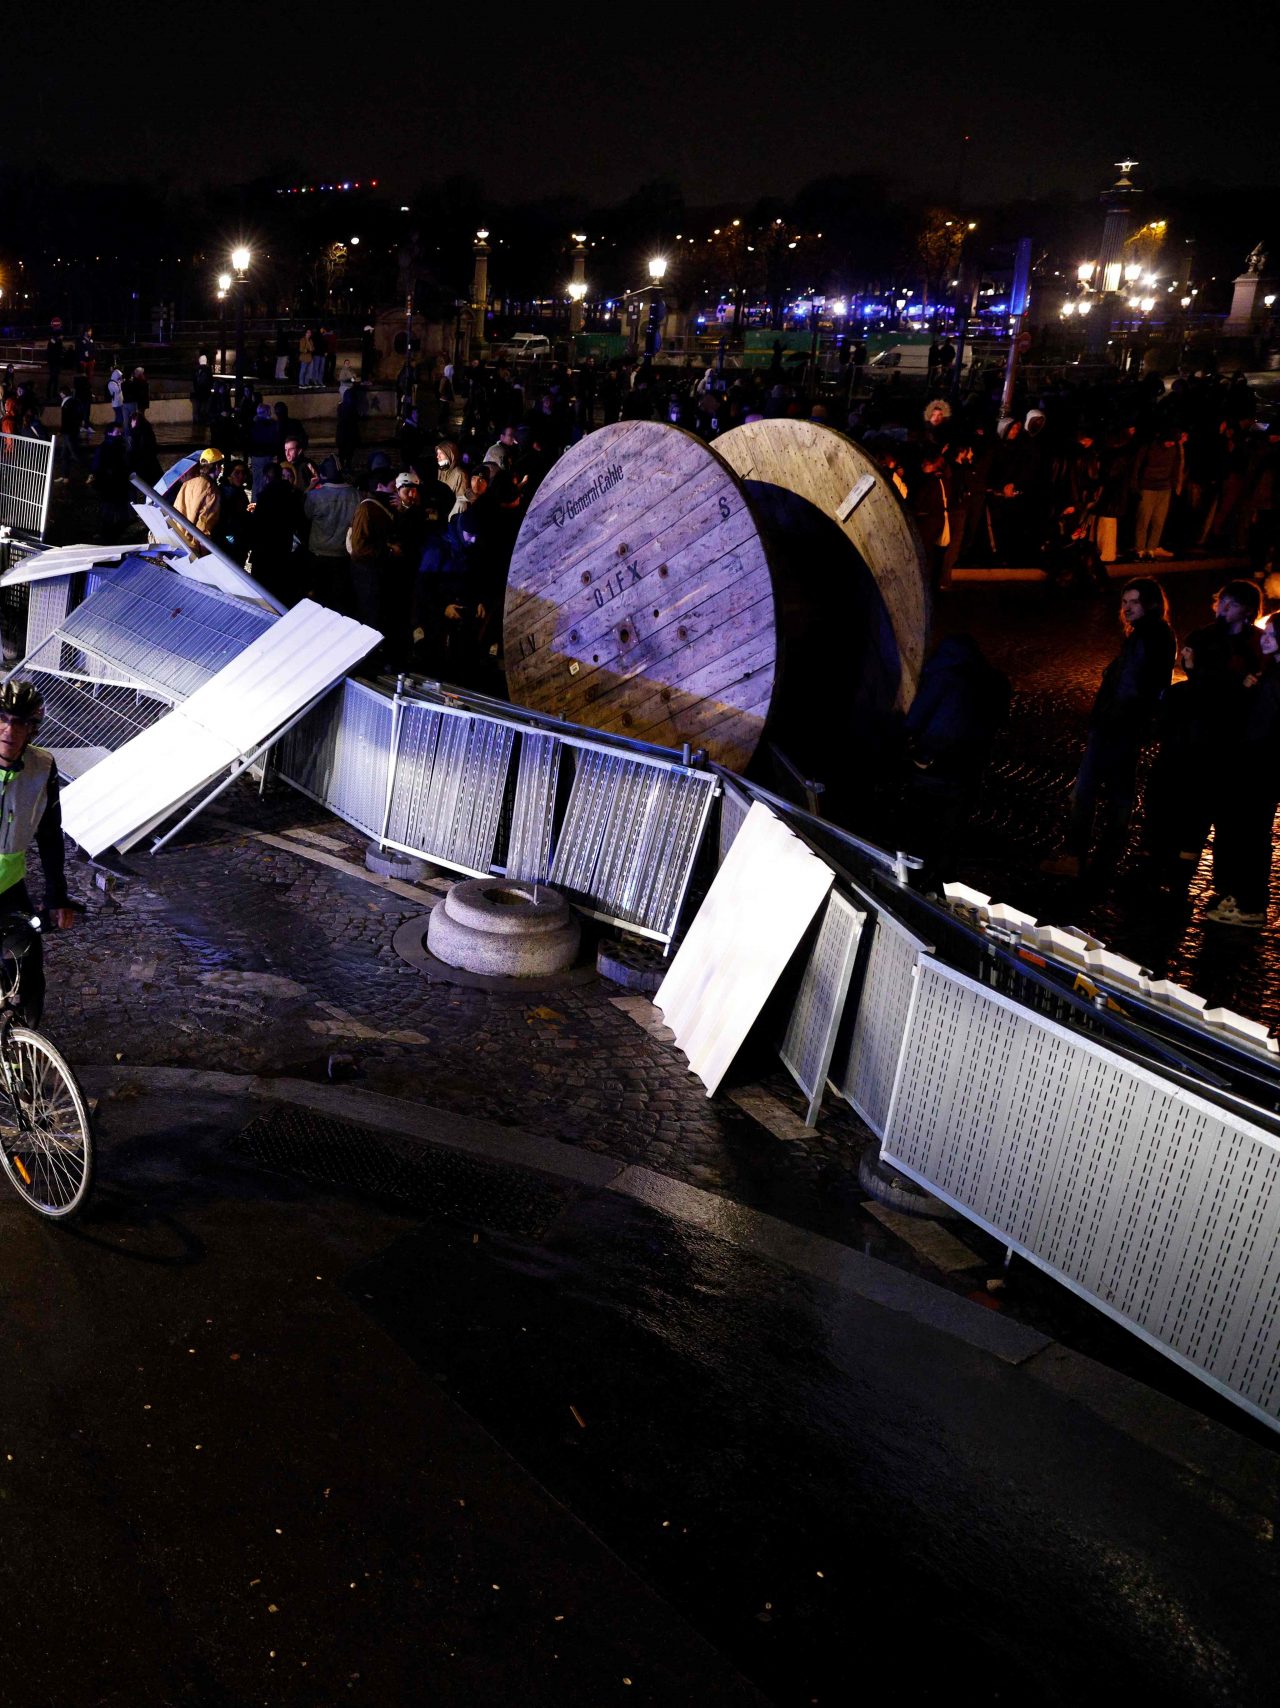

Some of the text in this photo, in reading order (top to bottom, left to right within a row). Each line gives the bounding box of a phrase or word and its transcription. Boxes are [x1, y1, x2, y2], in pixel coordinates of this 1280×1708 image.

[566, 463, 624, 520] General Cable
[719, 496, 731, 519] S
